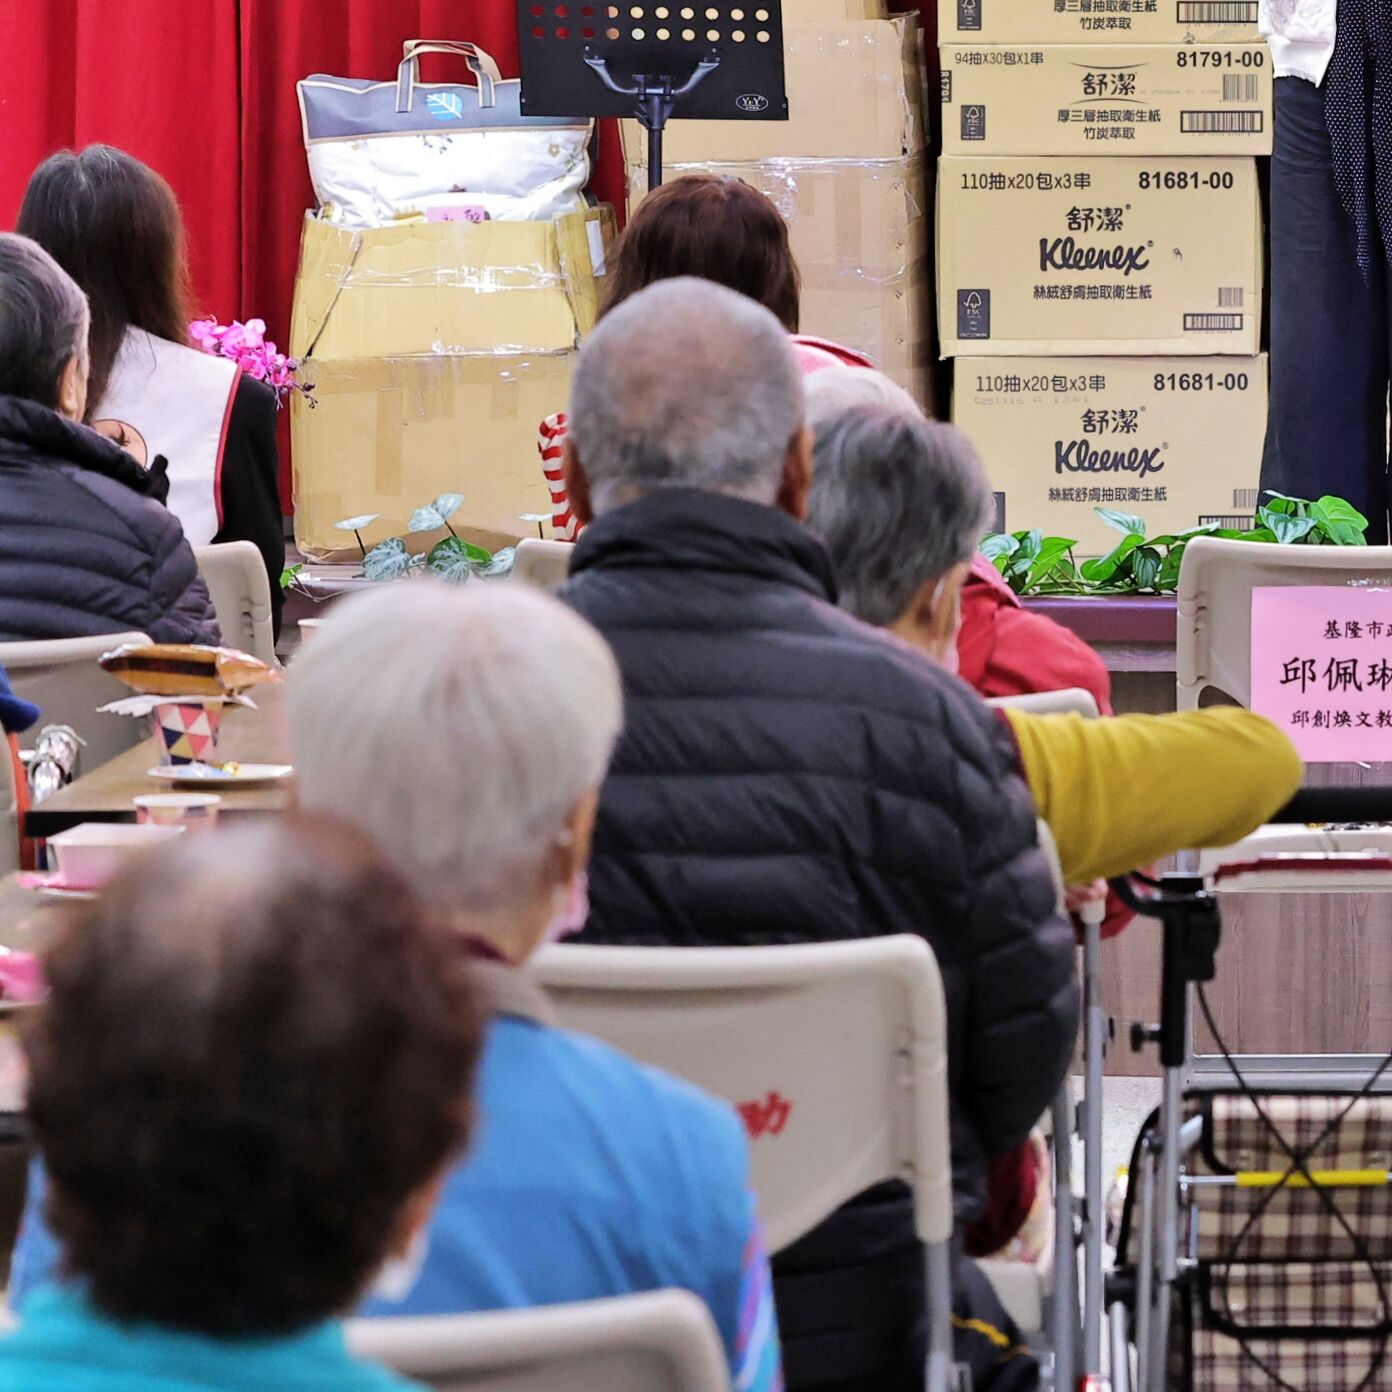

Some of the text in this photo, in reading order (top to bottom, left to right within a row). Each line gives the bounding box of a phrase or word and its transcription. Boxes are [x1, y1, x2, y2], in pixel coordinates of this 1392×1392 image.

[1054, 0, 1157, 13] 厚三層抽取衛生紙
[1080, 17, 1132, 30] 竹炭萃取
[955, 52, 1264, 68] 94抽X30包X1串 81791-00
[1081, 73, 1136, 96] 舒潔
[1057, 110, 1161, 123] 厚三層抽取衛生紙
[1084, 127, 1135, 140] 竹炭萃取
[961, 172, 1233, 190] 110抽x20包x3串 81681-00
[1065, 207, 1123, 233] 舒潔
[1039, 237, 1149, 276] Kleenex
[1033, 285, 1152, 300] 絲絨舒膚抽取衛生紙
[976, 373, 1248, 393] 110抽x20包x3串 81681-00
[1081, 409, 1139, 435] 舒潔
[1054, 439, 1165, 478] Kleenex
[1048, 487, 1167, 502] 絲絨舒膚抽取衛生紙
